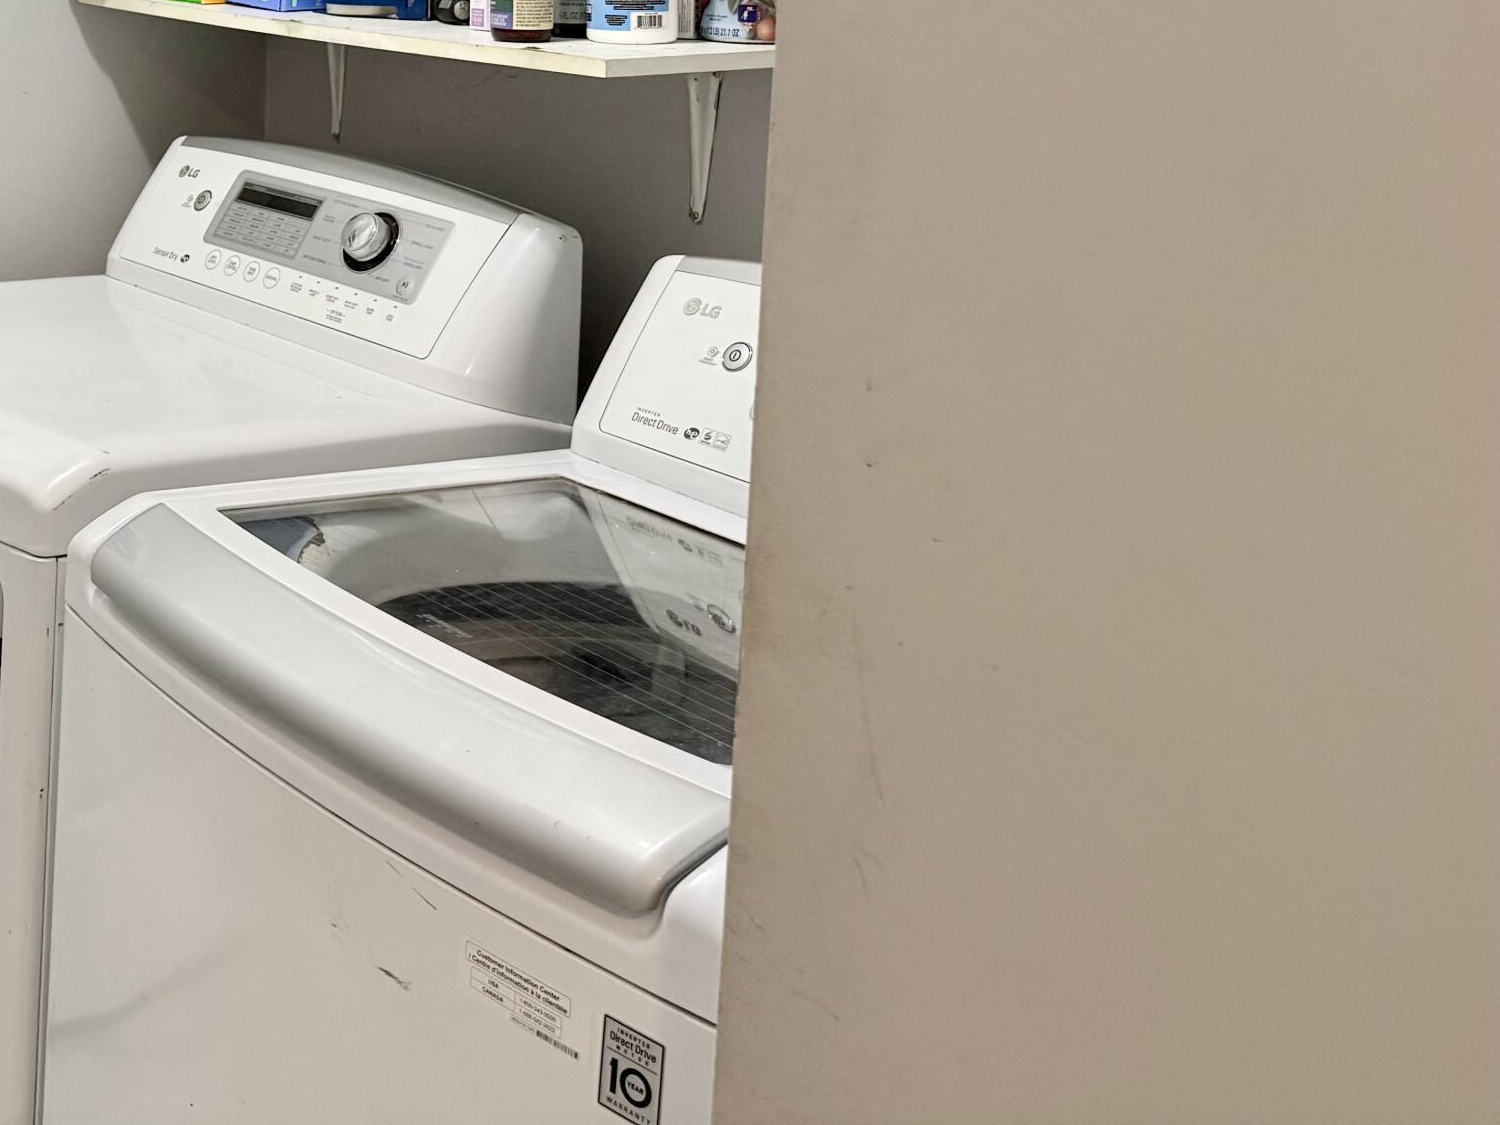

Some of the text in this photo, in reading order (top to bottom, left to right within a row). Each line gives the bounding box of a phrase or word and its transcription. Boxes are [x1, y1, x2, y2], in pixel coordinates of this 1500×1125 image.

[631, 411, 657, 428] Direct
[656, 417, 679, 435] Drive
[476, 949, 560, 1001] Customer Information Center
[609, 1030, 657, 1063] Direct Drive
[609, 1057, 652, 1108] 10
[627, 1081, 644, 1095] YEAR
[606, 1096, 651, 1124] WARRANTY
